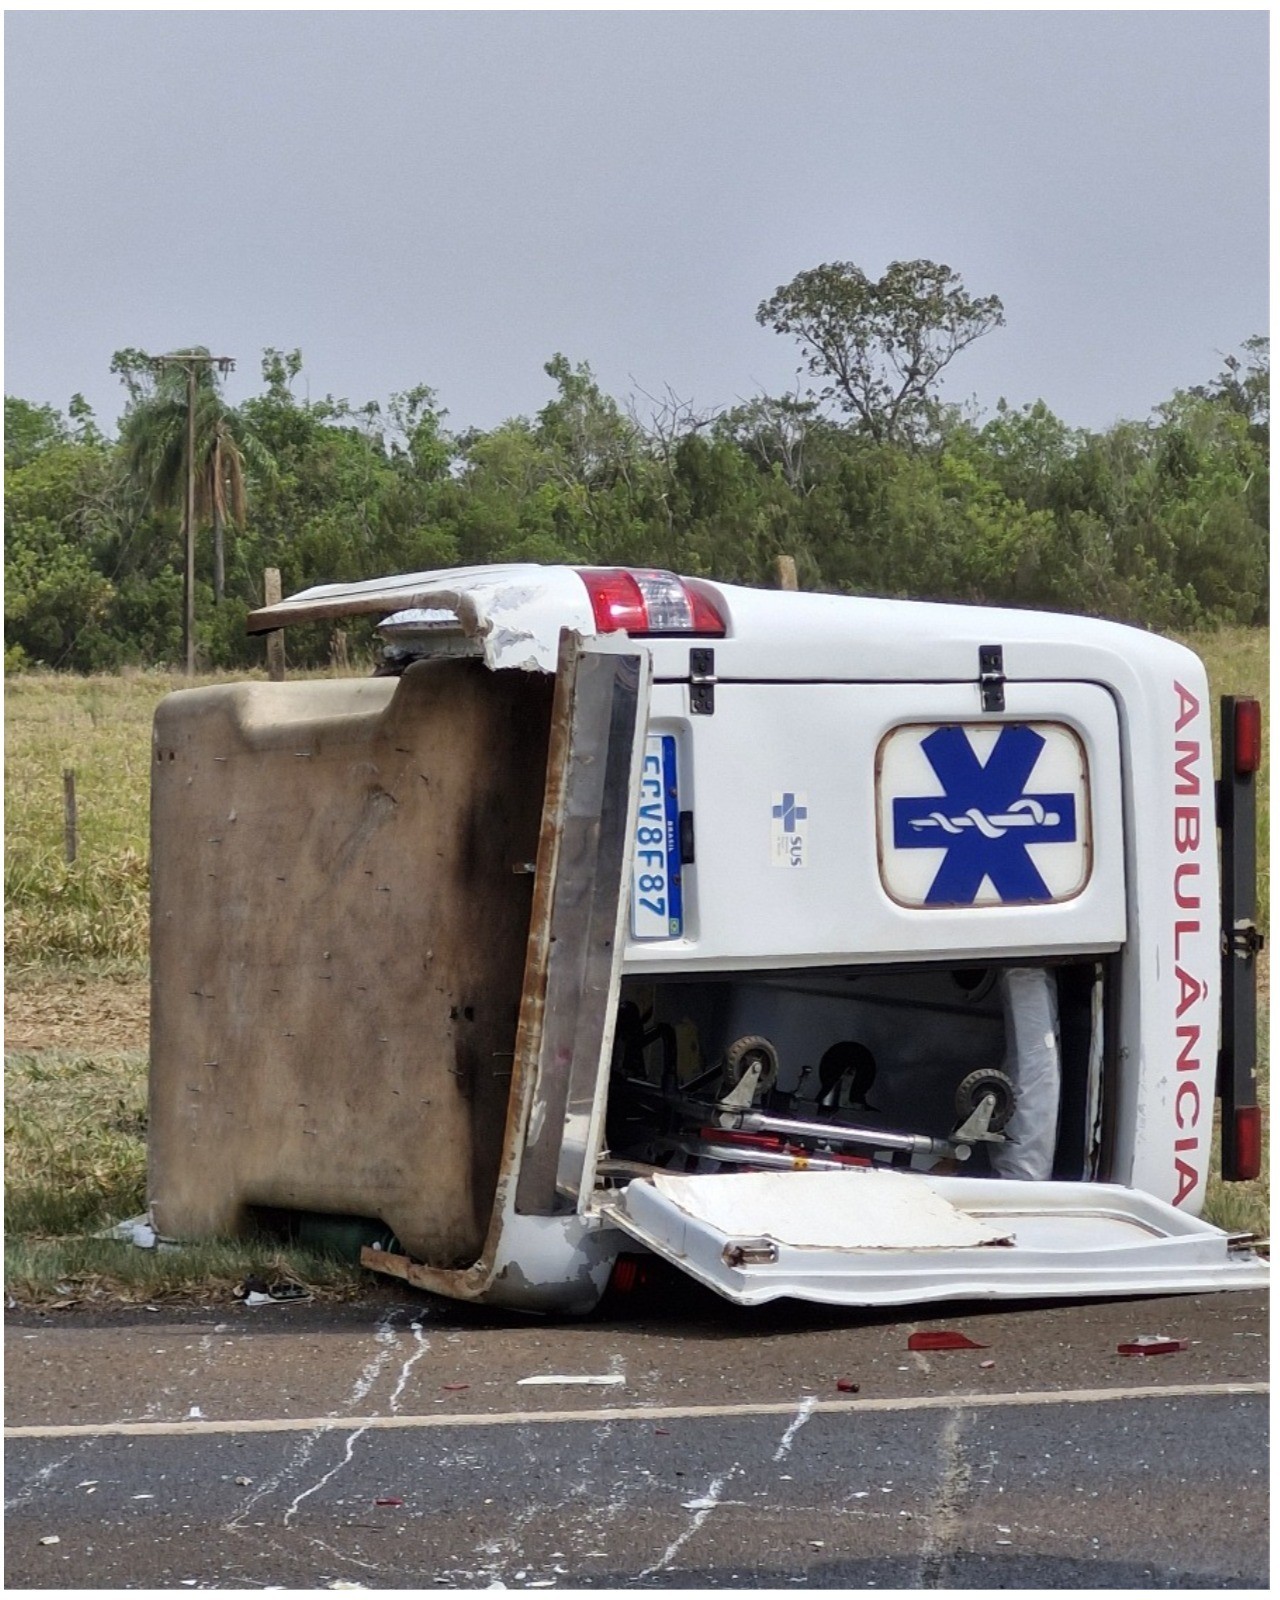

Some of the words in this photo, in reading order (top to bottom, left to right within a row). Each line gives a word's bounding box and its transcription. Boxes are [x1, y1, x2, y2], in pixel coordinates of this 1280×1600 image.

[667, 820, 675, 852] BRASIL
[789, 835, 803, 867] SUS
[1173, 679, 1209, 1207] AMBULÂNCIA
